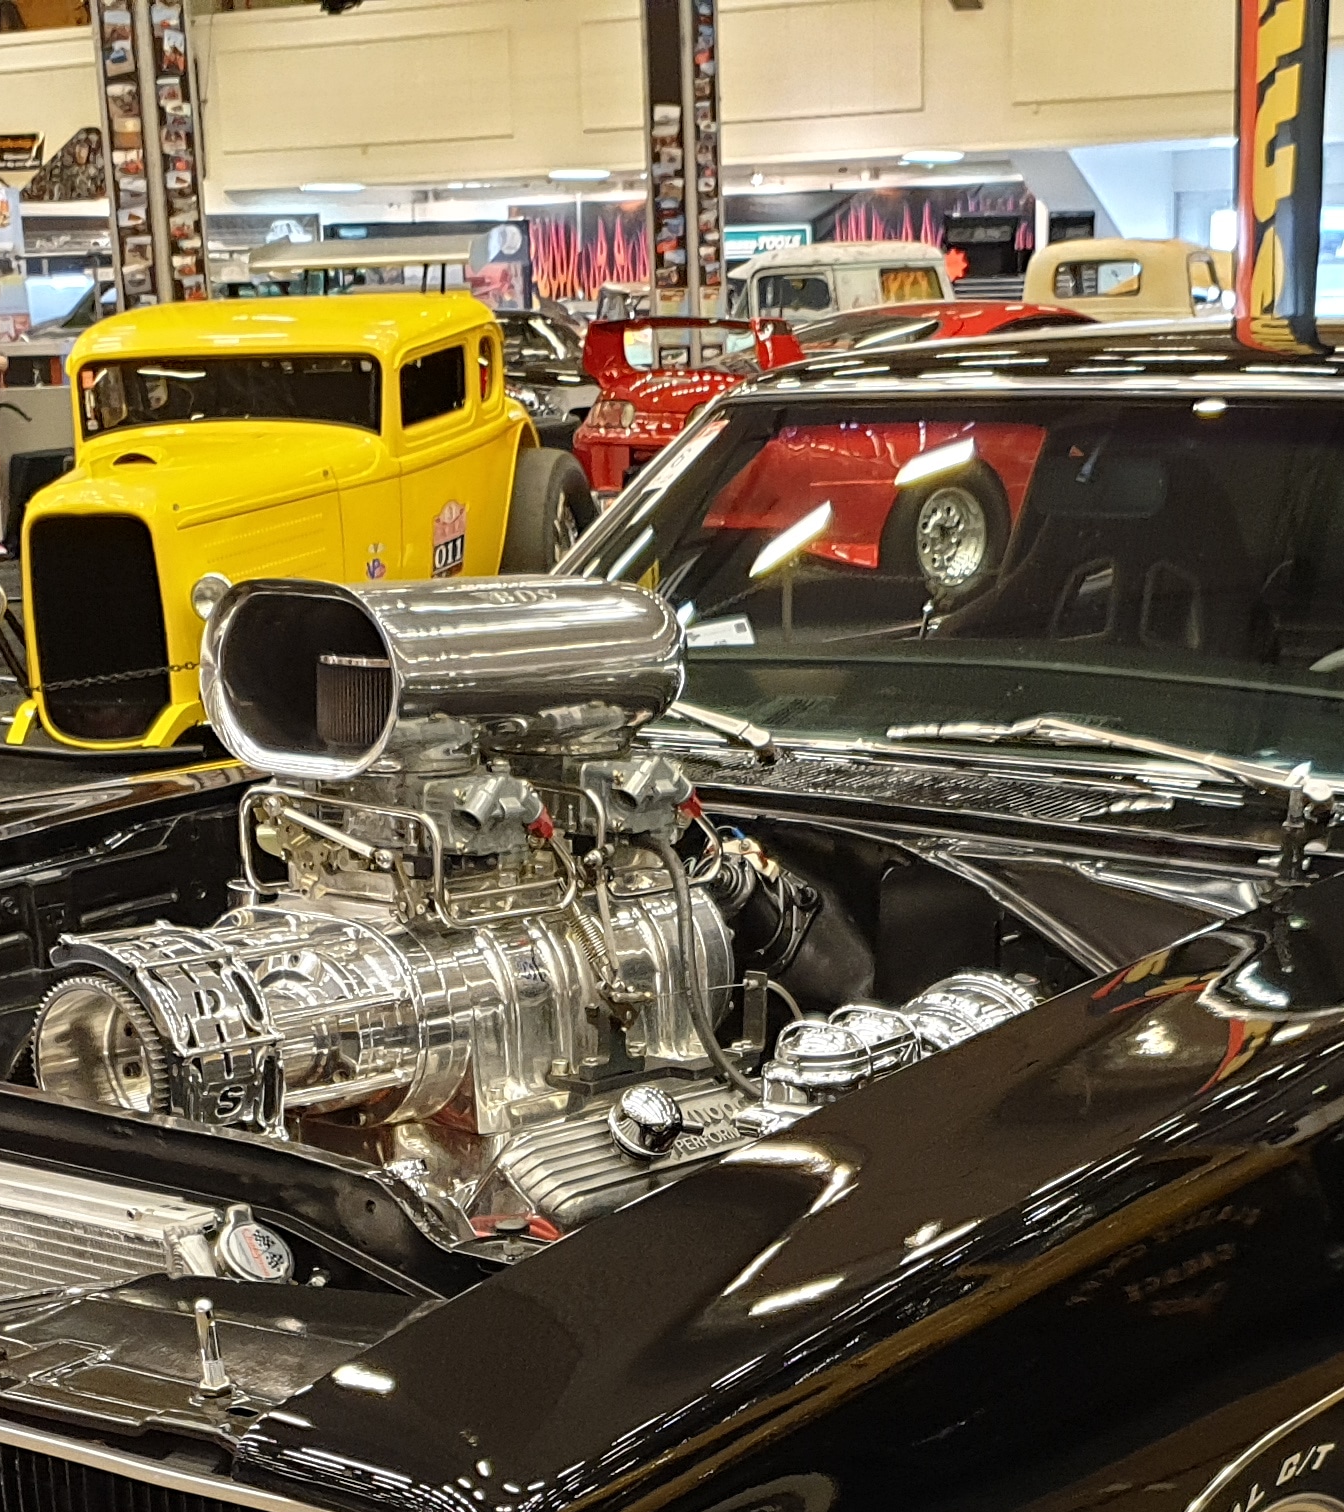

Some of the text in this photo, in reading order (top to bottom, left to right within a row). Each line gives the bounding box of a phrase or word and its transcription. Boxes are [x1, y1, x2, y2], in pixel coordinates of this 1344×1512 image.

[434, 535, 464, 568] 011
[489, 588, 557, 604] BDS
[1276, 1443, 1335, 1486] G/T
